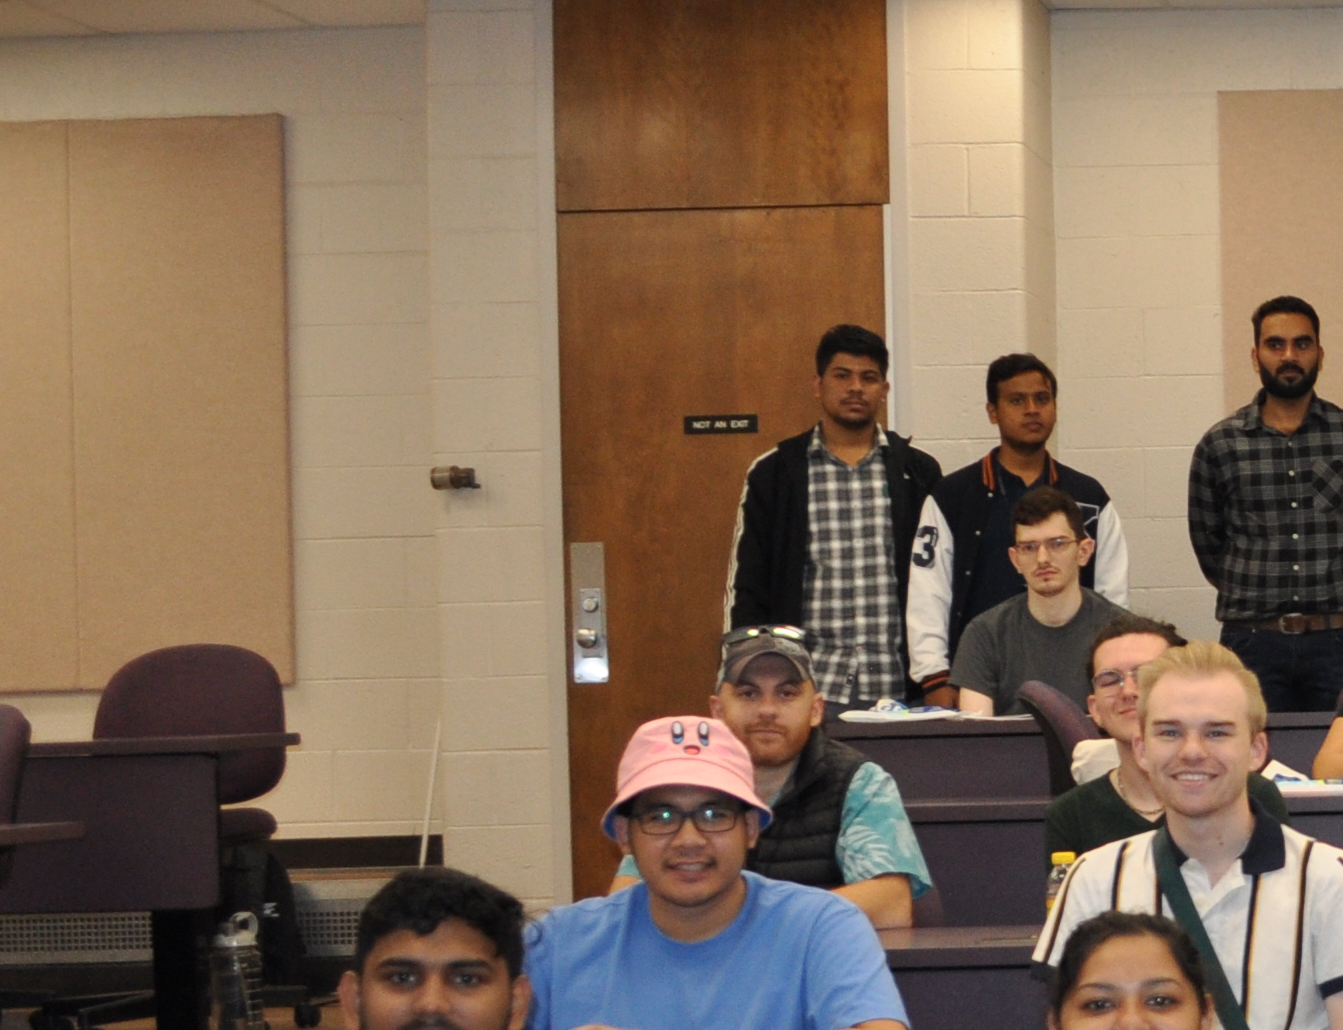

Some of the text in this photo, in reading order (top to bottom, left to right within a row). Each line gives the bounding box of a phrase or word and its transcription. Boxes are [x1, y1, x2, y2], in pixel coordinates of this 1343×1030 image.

[692, 419, 749, 429] NOT AN EXIT
[912, 525, 939, 570] 3
